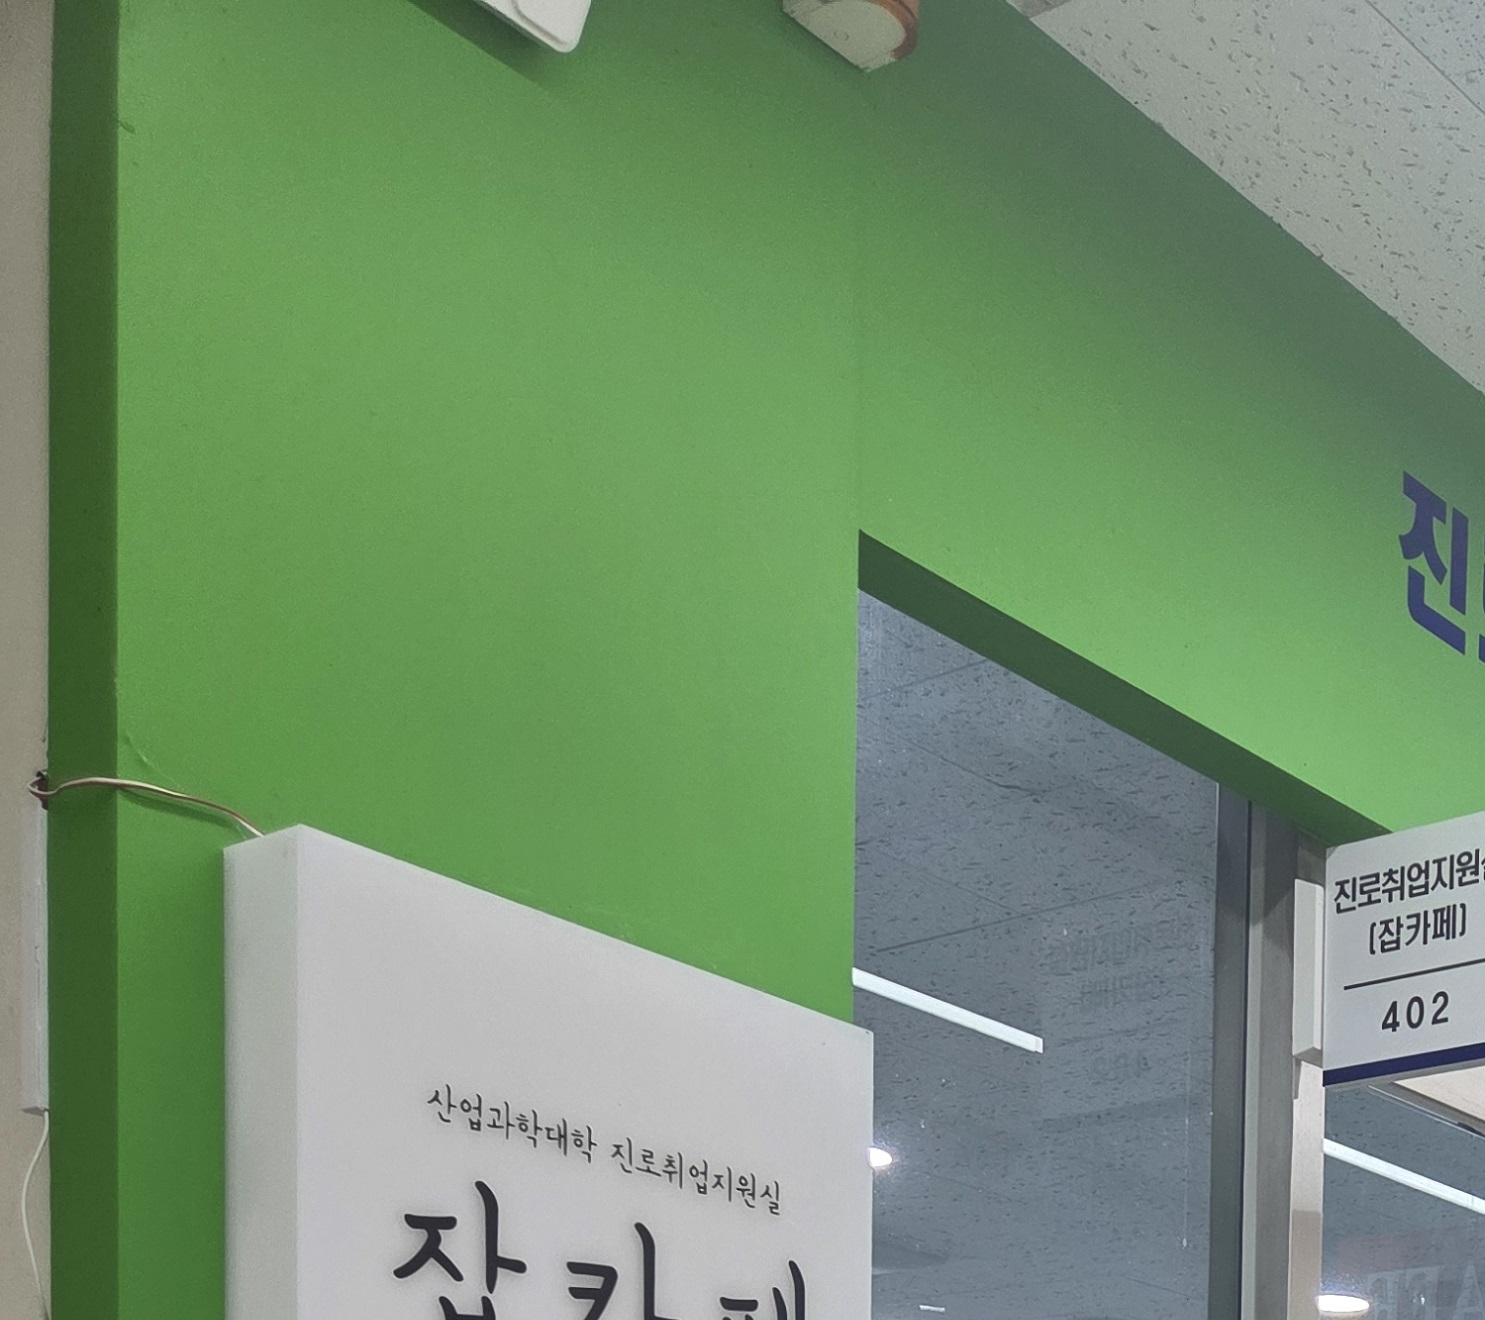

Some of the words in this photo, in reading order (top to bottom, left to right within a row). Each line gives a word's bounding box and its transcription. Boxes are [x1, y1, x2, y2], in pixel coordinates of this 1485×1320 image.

[1381, 991, 1449, 1033] 402
[426, 1083, 598, 1164] 산업과학대학
[611, 1137, 782, 1216] 진로취업지원실
